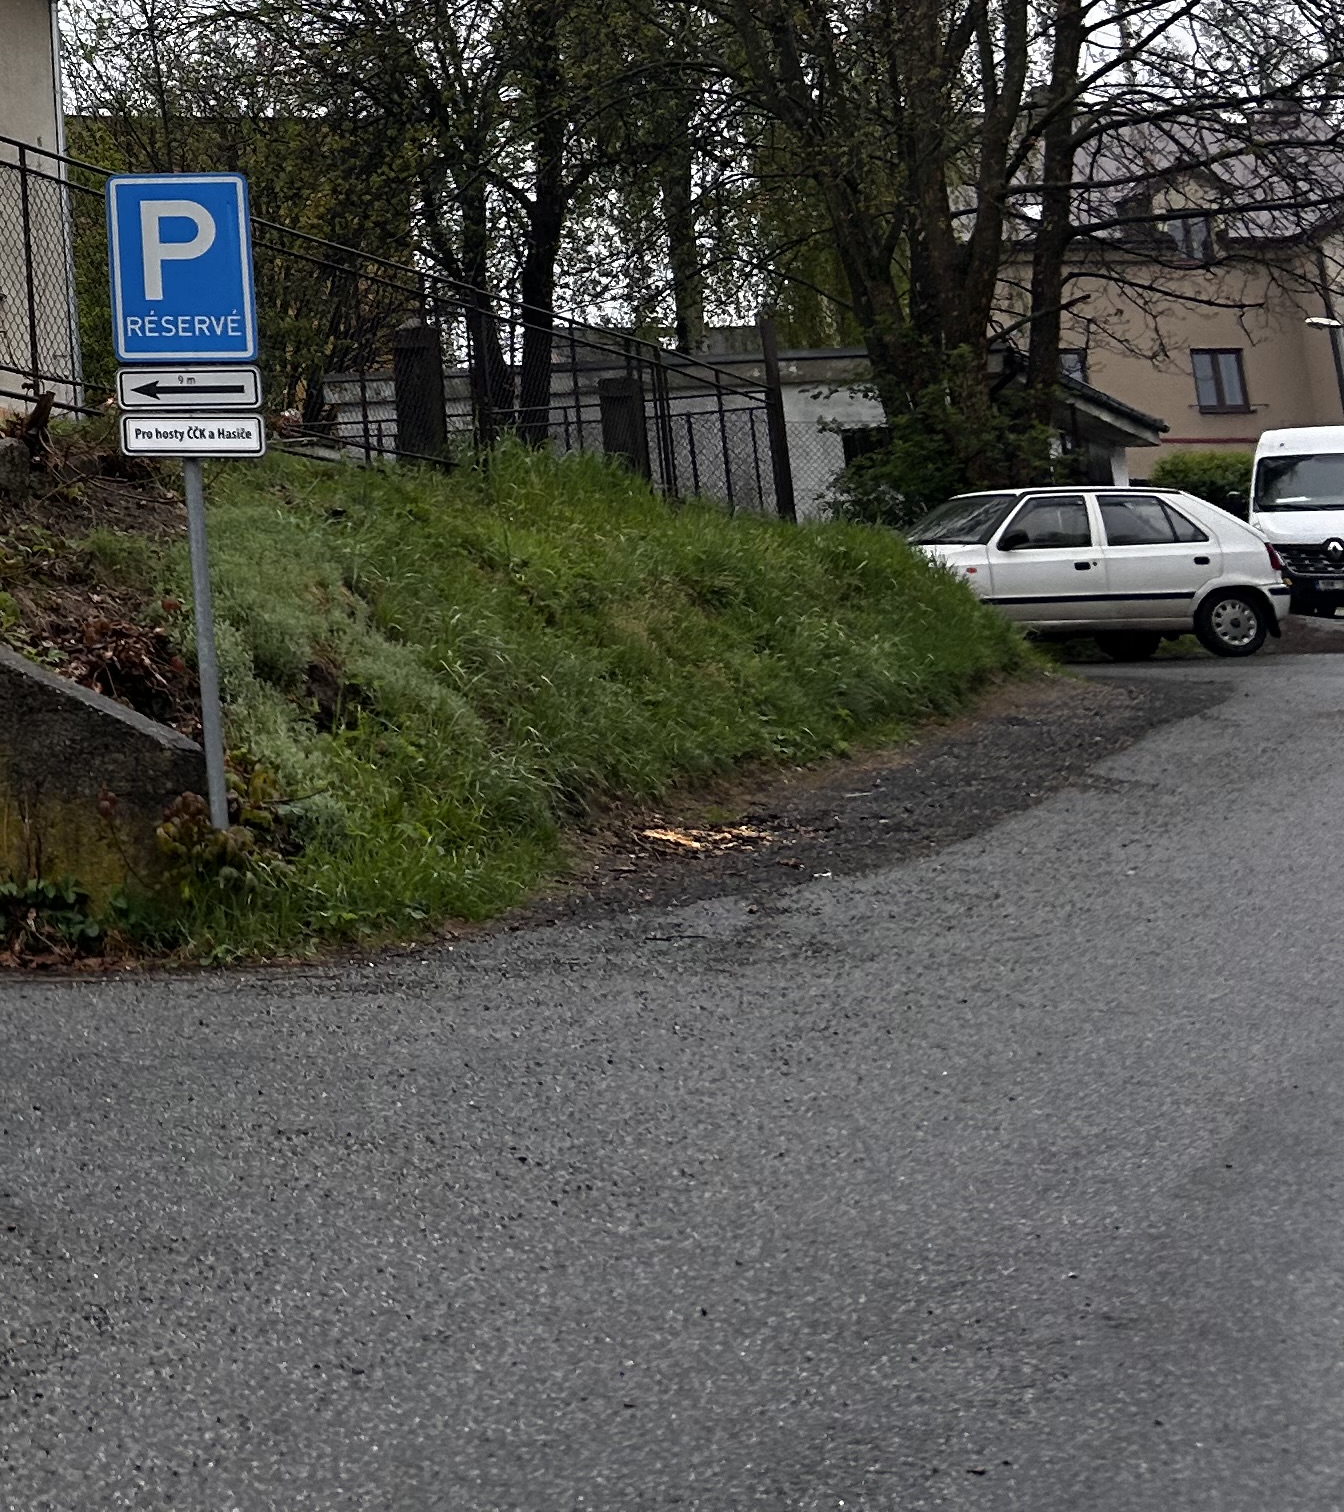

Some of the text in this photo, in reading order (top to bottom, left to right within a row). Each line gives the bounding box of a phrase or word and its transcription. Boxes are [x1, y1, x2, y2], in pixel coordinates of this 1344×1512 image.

[139, 200, 216, 301] P
[126, 309, 242, 337] RÉSERVÉ
[177, 375, 196, 385] 9 m
[134, 425, 252, 442] Pro hosty ČČK a Hasiče
